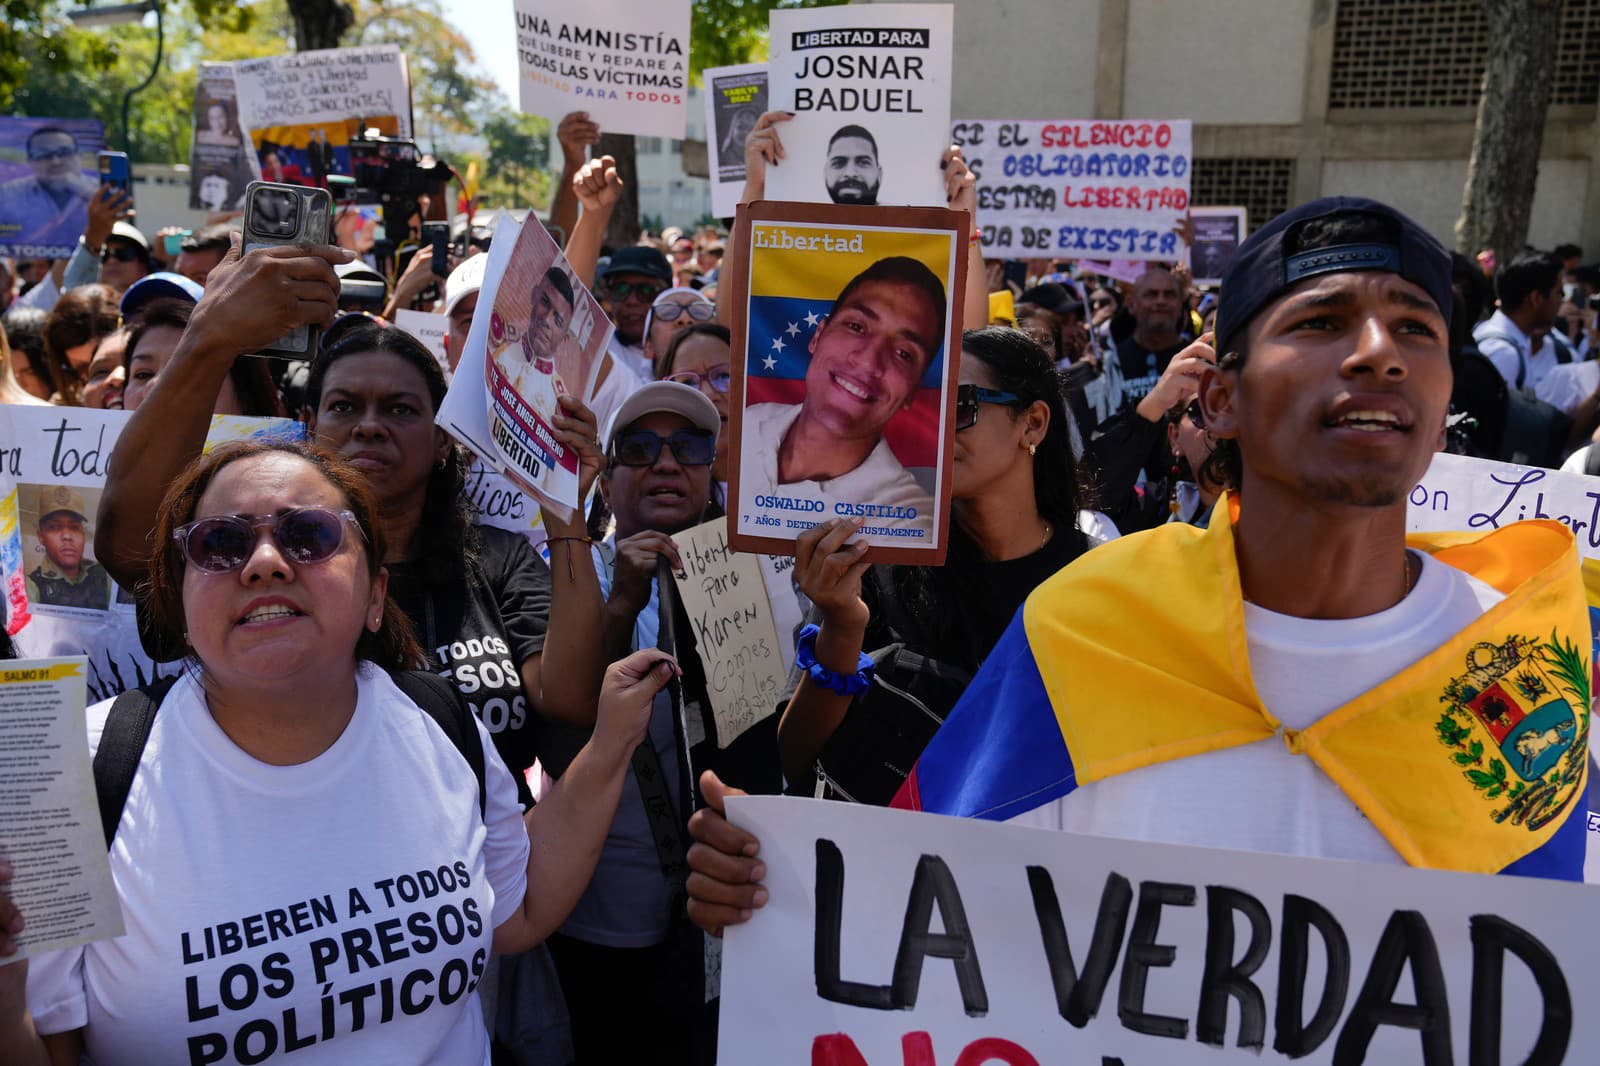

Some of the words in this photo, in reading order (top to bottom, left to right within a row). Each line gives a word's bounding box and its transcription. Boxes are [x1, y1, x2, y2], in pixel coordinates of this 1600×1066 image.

[516, 12, 551, 38] UNA
[558, 24, 683, 56] AMNISTÍA
[796, 31, 875, 48] LIBERTAD
[879, 31, 924, 46] PARA
[519, 49, 557, 73] TODAS
[560, 62, 588, 80] LAS
[594, 67, 683, 89] VÍCTIMAS
[541, 42, 581, 61] LIBERE
[588, 52, 596, 62] Y
[603, 54, 666, 71] REPARE
[674, 61, 683, 71] A
[795, 55, 923, 80] JOSNAR
[576, 86, 618, 100] PARA
[626, 91, 681, 104] TODOS
[795, 88, 923, 113] BADUEL
[952, 123, 984, 148] SI
[997, 123, 1029, 148] EL
[1040, 123, 1172, 149] SILENCIO
[964, 158, 983, 181] S
[1003, 153, 1188, 178] OBLIGATORIO
[1064, 185, 1189, 211] LIBERTAD
[754, 228, 864, 254] Libertad
[1021, 226, 1052, 250] DE
[1058, 226, 1177, 254] EXISTIR
[500, 386, 516, 410] JOSE
[535, 421, 565, 459] BARRENO
[492, 417, 540, 480] LIBERTAD
[754, 494, 825, 513] OSWALDO
[834, 502, 918, 520] CASTILLO
[743, 514, 750, 523] 7
[755, 514, 781, 528] AÑOS
[855, 526, 925, 538] JUSTAMENTE
[436, 635, 509, 665] TODOS
[4, 670, 37, 681] SALMO
[39, 670, 50, 680] 91
[438, 659, 521, 694] SOS
[468, 695, 526, 734] OS
[181, 894, 338, 965] LIBEREN
[348, 887, 372, 919] A
[374, 861, 471, 908] TODOS
[185, 951, 295, 1023] LOS
[309, 897, 483, 985] PRESOS
[814, 838, 989, 1017] LA
[1025, 864, 1572, 1066] VERDAD
[186, 947, 487, 1066] POLÍTICOS
